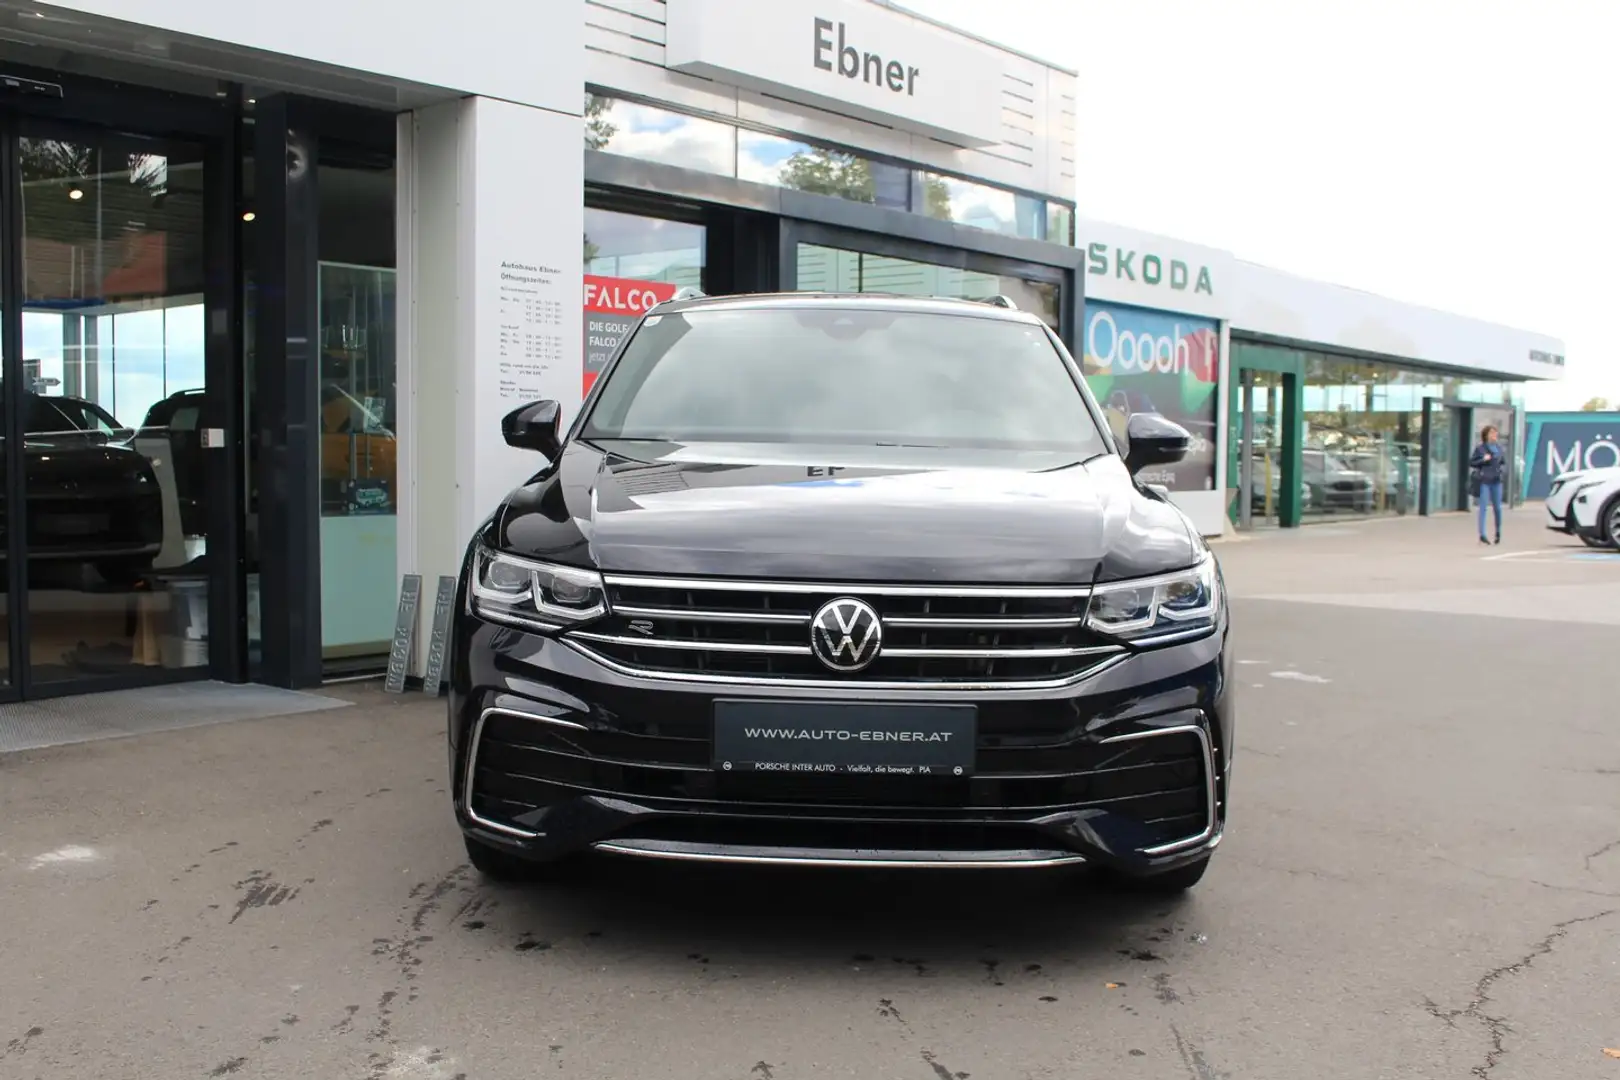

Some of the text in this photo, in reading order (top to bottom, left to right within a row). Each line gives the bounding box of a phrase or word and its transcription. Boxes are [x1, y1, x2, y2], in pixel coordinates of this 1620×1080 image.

[814, 16, 919, 96] Ebner
[583, 284, 657, 311] FALCO
[590, 321, 604, 331] DIE
[590, 336, 617, 347] FALCO
[1088, 311, 1190, 374] Ooooh
[744, 727, 952, 742] WWW.AUTO-EBNER.AT
[755, 762, 790, 771] PORSCHE
[792, 763, 813, 772] INTER
[814, 764, 836, 772] AUTO
[847, 764, 873, 773] Vielfalt,
[875, 765, 886, 773] die
[888, 765, 914, 775] bewegt.
